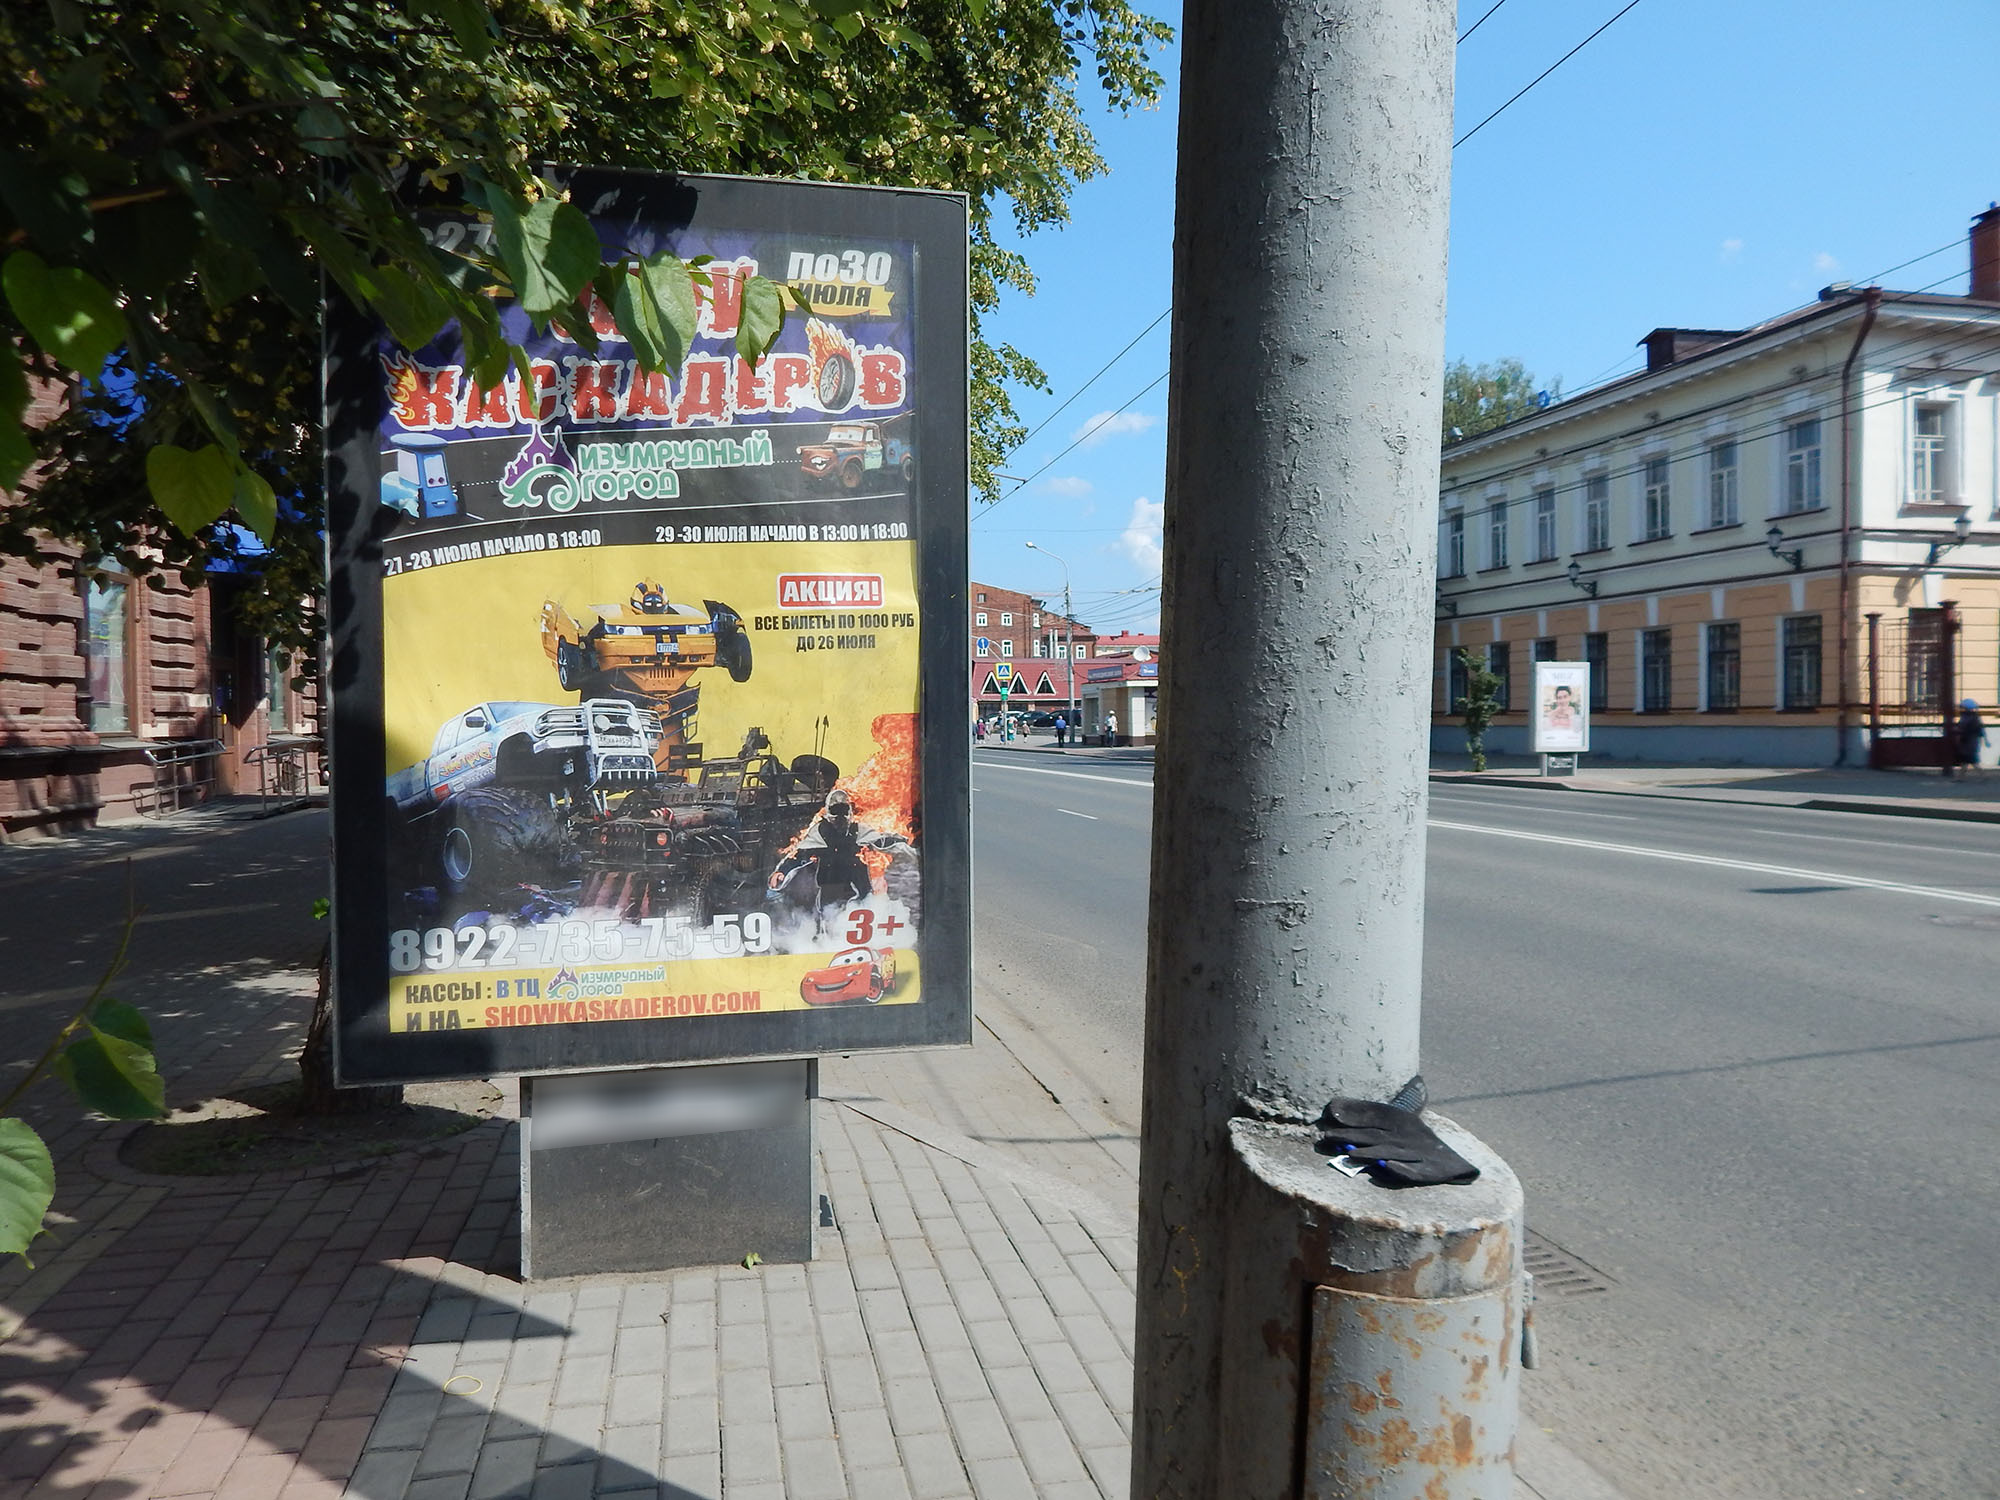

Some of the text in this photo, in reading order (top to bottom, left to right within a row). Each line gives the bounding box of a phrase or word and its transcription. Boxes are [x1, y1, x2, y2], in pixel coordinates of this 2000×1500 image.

[797, 283, 872, 307] ИЮЛЯ
[578, 430, 773, 472] ИЗУМРУДНЫЙ
[580, 470, 680, 502] ГОРОД
[704, 526, 748, 542] ИЮЛЯ
[750, 525, 807, 541] НАЧАЛО
[809, 525, 819, 541] В
[820, 524, 858, 540] 13:00
[860, 524, 870, 540] И
[871, 522, 908, 539] 18:00
[433, 543, 483, 565] ИЮЛЯ
[484, 533, 545, 557] НАЧАЛО
[548, 532, 559, 549] В
[560, 529, 601, 548] 18:00
[783, 580, 879, 604] АКЦИЯ!
[754, 613, 914, 630] ВСЕ БИЛЕТЫ ПО 1000 РУБ
[796, 634, 876, 652] ДО 26 ИЮЛЯ
[846, 909, 904, 945] 3+
[390, 911, 772, 972] 8922-735-75-59
[581, 966, 665, 983] ИЗУМРУДНЫЙ
[497, 980, 510, 998] В
[514, 979, 540, 999] ТЦ
[580, 983, 623, 997] ГОРОД
[406, 1012, 422, 1031] И
[429, 1009, 462, 1031] НА
[485, 991, 761, 1027] SHOWKASKADEROV.COM
